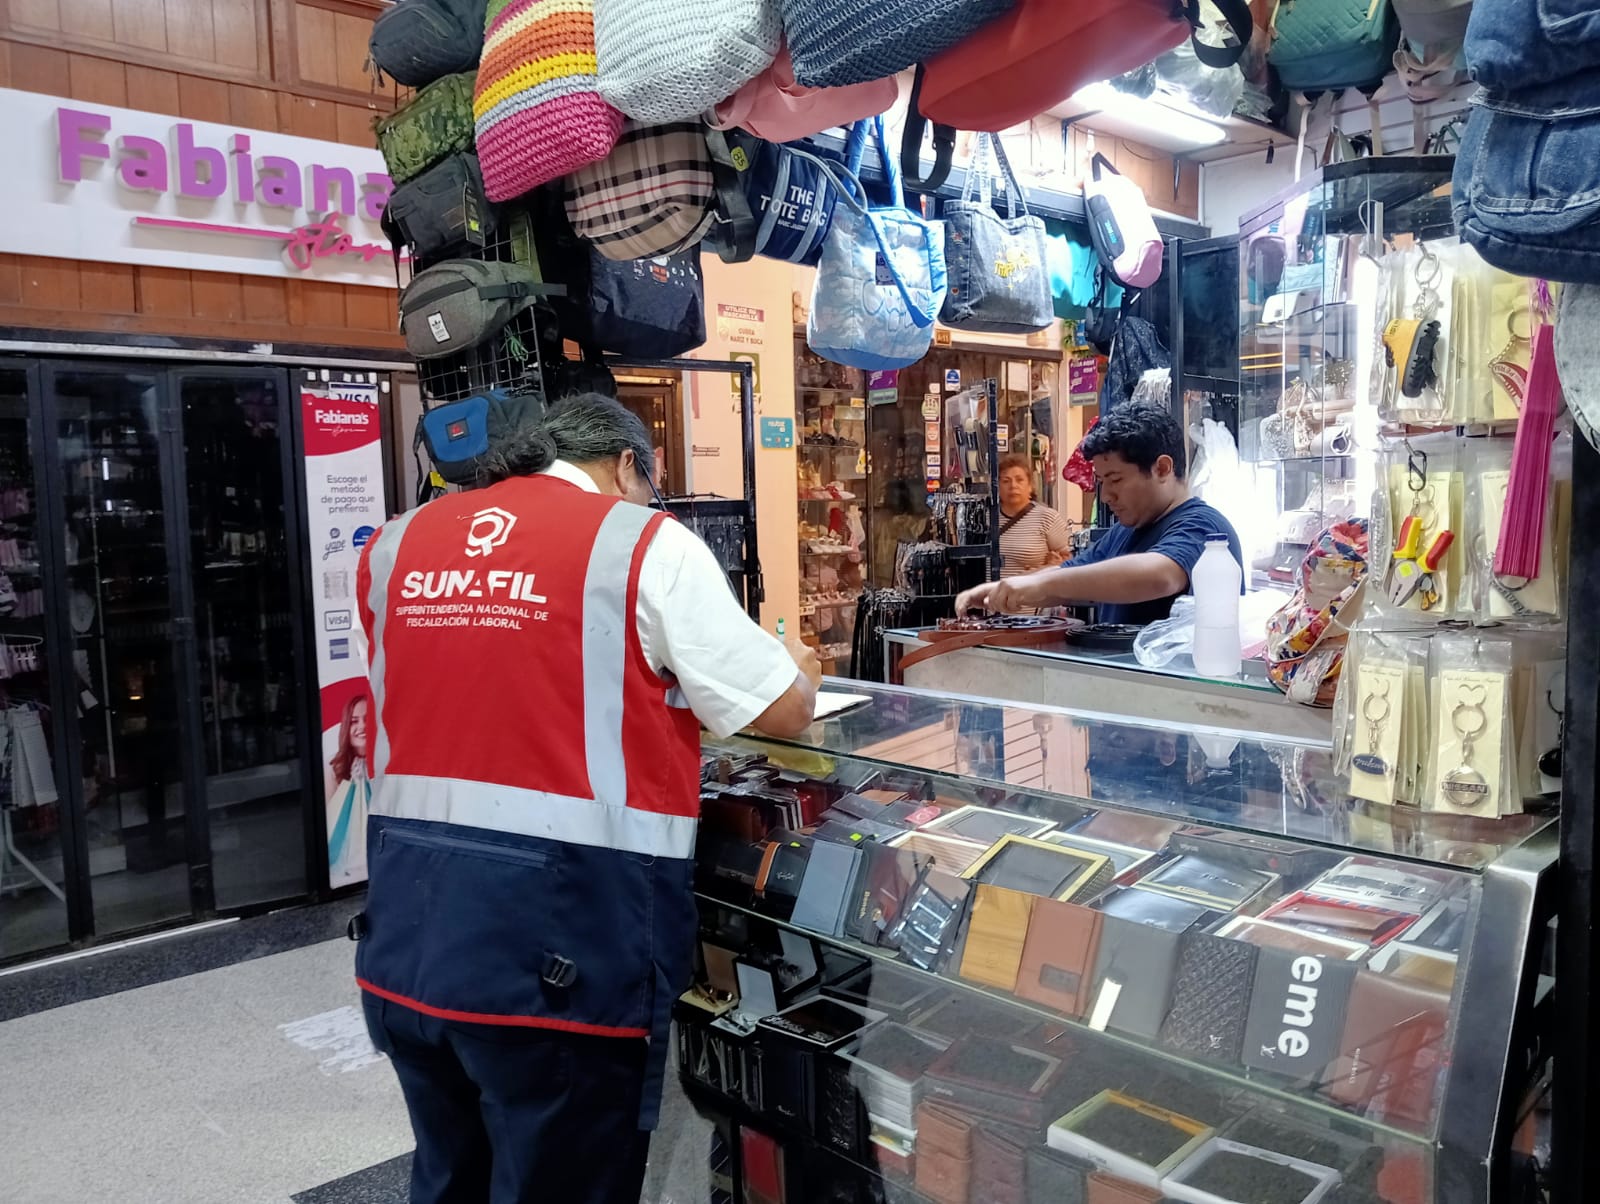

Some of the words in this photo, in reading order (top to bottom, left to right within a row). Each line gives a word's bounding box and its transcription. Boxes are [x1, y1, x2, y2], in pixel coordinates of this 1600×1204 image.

[56, 107, 393, 219] Fabiana
[790, 185, 815, 206] THE
[760, 195, 799, 220] TOTE
[801, 208, 827, 226] BAG
[315, 409, 369, 425] Fabiana's
[327, 474, 358, 486] Escoge
[359, 474, 368, 483] el
[334, 496, 357, 506] pago
[358, 496, 375, 504] que
[329, 504, 369, 515] prefieras
[401, 570, 547, 604] SUNAFIL
[396, 603, 474, 616] SUPERINTENDENCIA
[476, 603, 530, 619] NACIONAL
[534, 611, 549, 621] DE
[328, 616, 350, 625] VISA
[473, 616, 522, 630] LABORAL
[1442, 782, 1487, 793] NISSAN
[1277, 953, 1325, 1058] eme
